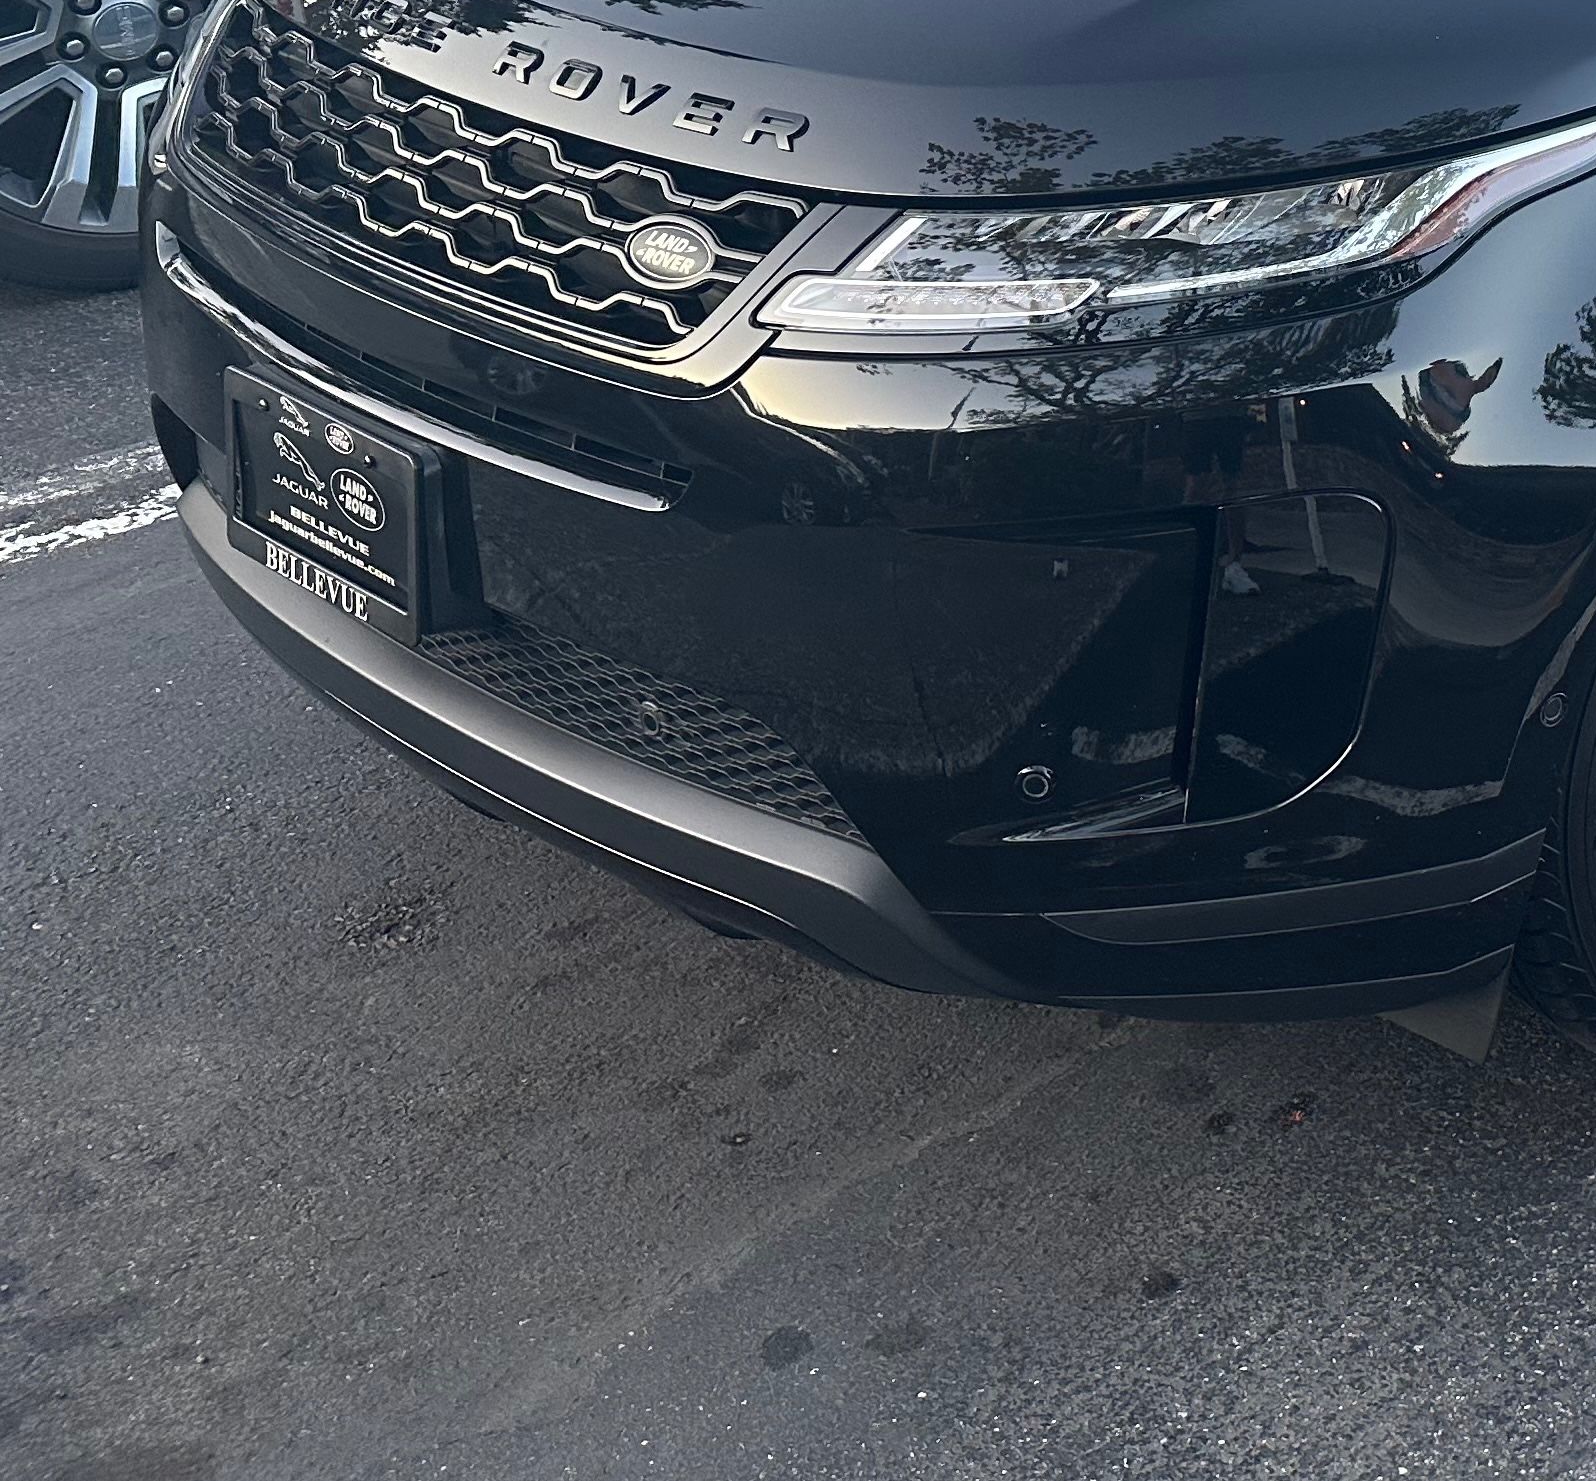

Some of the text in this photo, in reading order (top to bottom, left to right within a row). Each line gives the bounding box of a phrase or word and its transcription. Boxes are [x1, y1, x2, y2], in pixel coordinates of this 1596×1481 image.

[492, 40, 810, 153] ROVER
[645, 230, 690, 253] LAND
[642, 247, 696, 275] ROVER
[279, 416, 311, 437] JAGUAR
[272, 473, 329, 510] JAGUAR
[340, 474, 367, 502] LAND
[345, 494, 377, 525] ROVER
[290, 505, 370, 557] BELLEVUE
[265, 541, 368, 621] BELLEVUE
